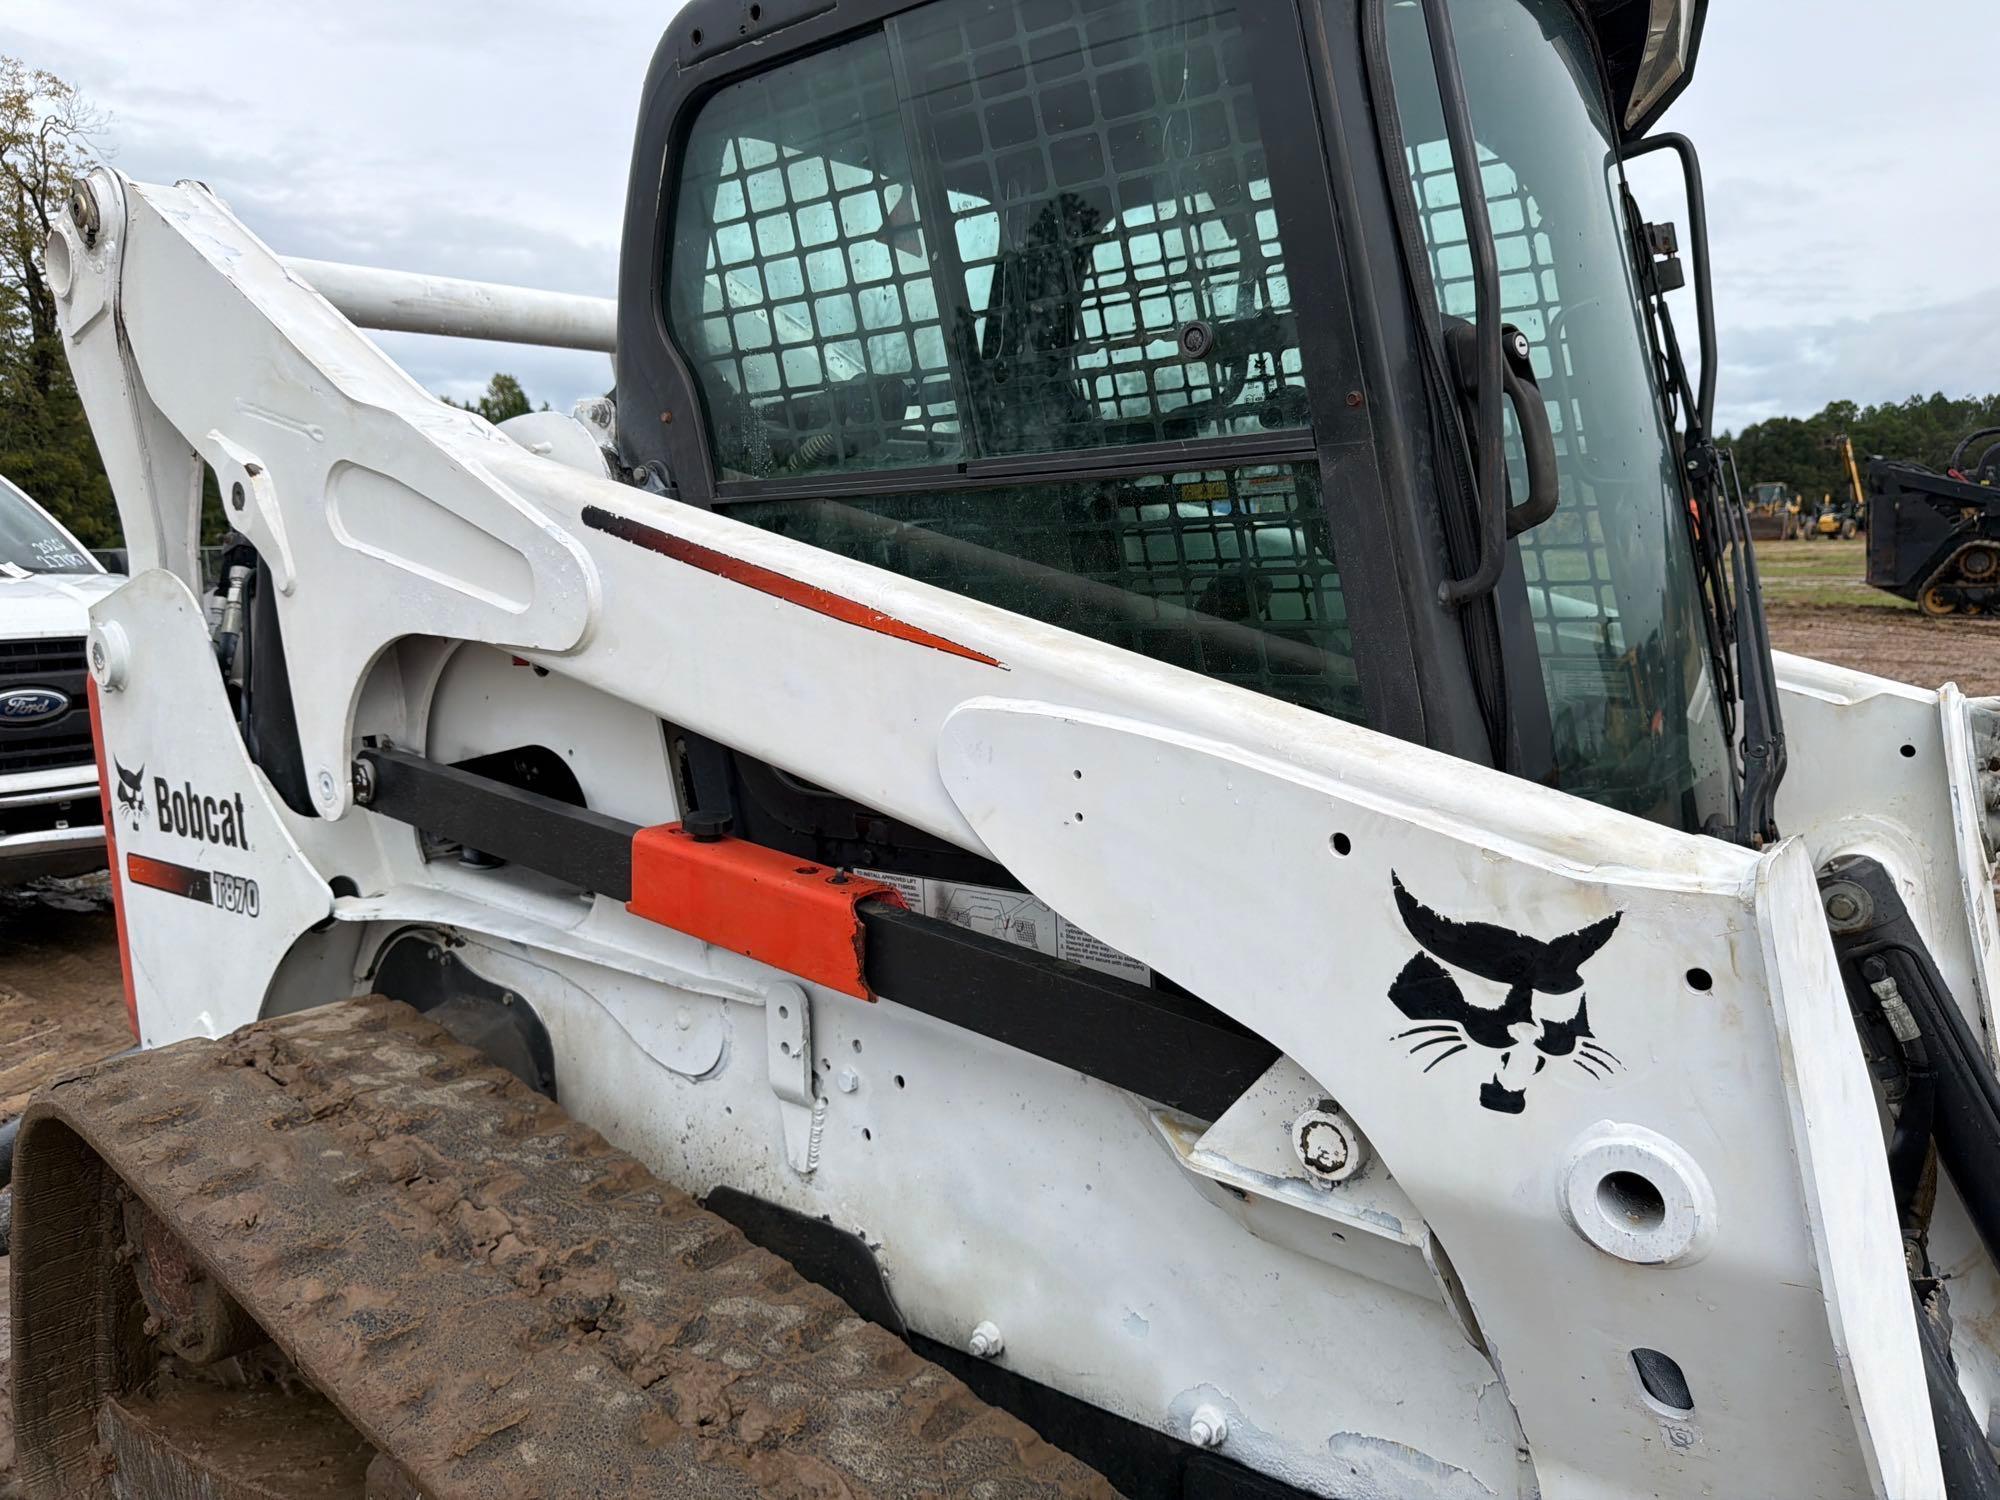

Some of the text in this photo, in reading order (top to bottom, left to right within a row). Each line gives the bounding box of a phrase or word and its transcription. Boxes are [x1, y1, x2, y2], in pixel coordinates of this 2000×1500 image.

[5, 696, 50, 714] Ford
[153, 776, 249, 851] Bobcat
[881, 873, 906, 883] APPROVED
[213, 871, 260, 918] T870
[1066, 933, 1076, 941] Stay
[1100, 951, 1117, 960] support
